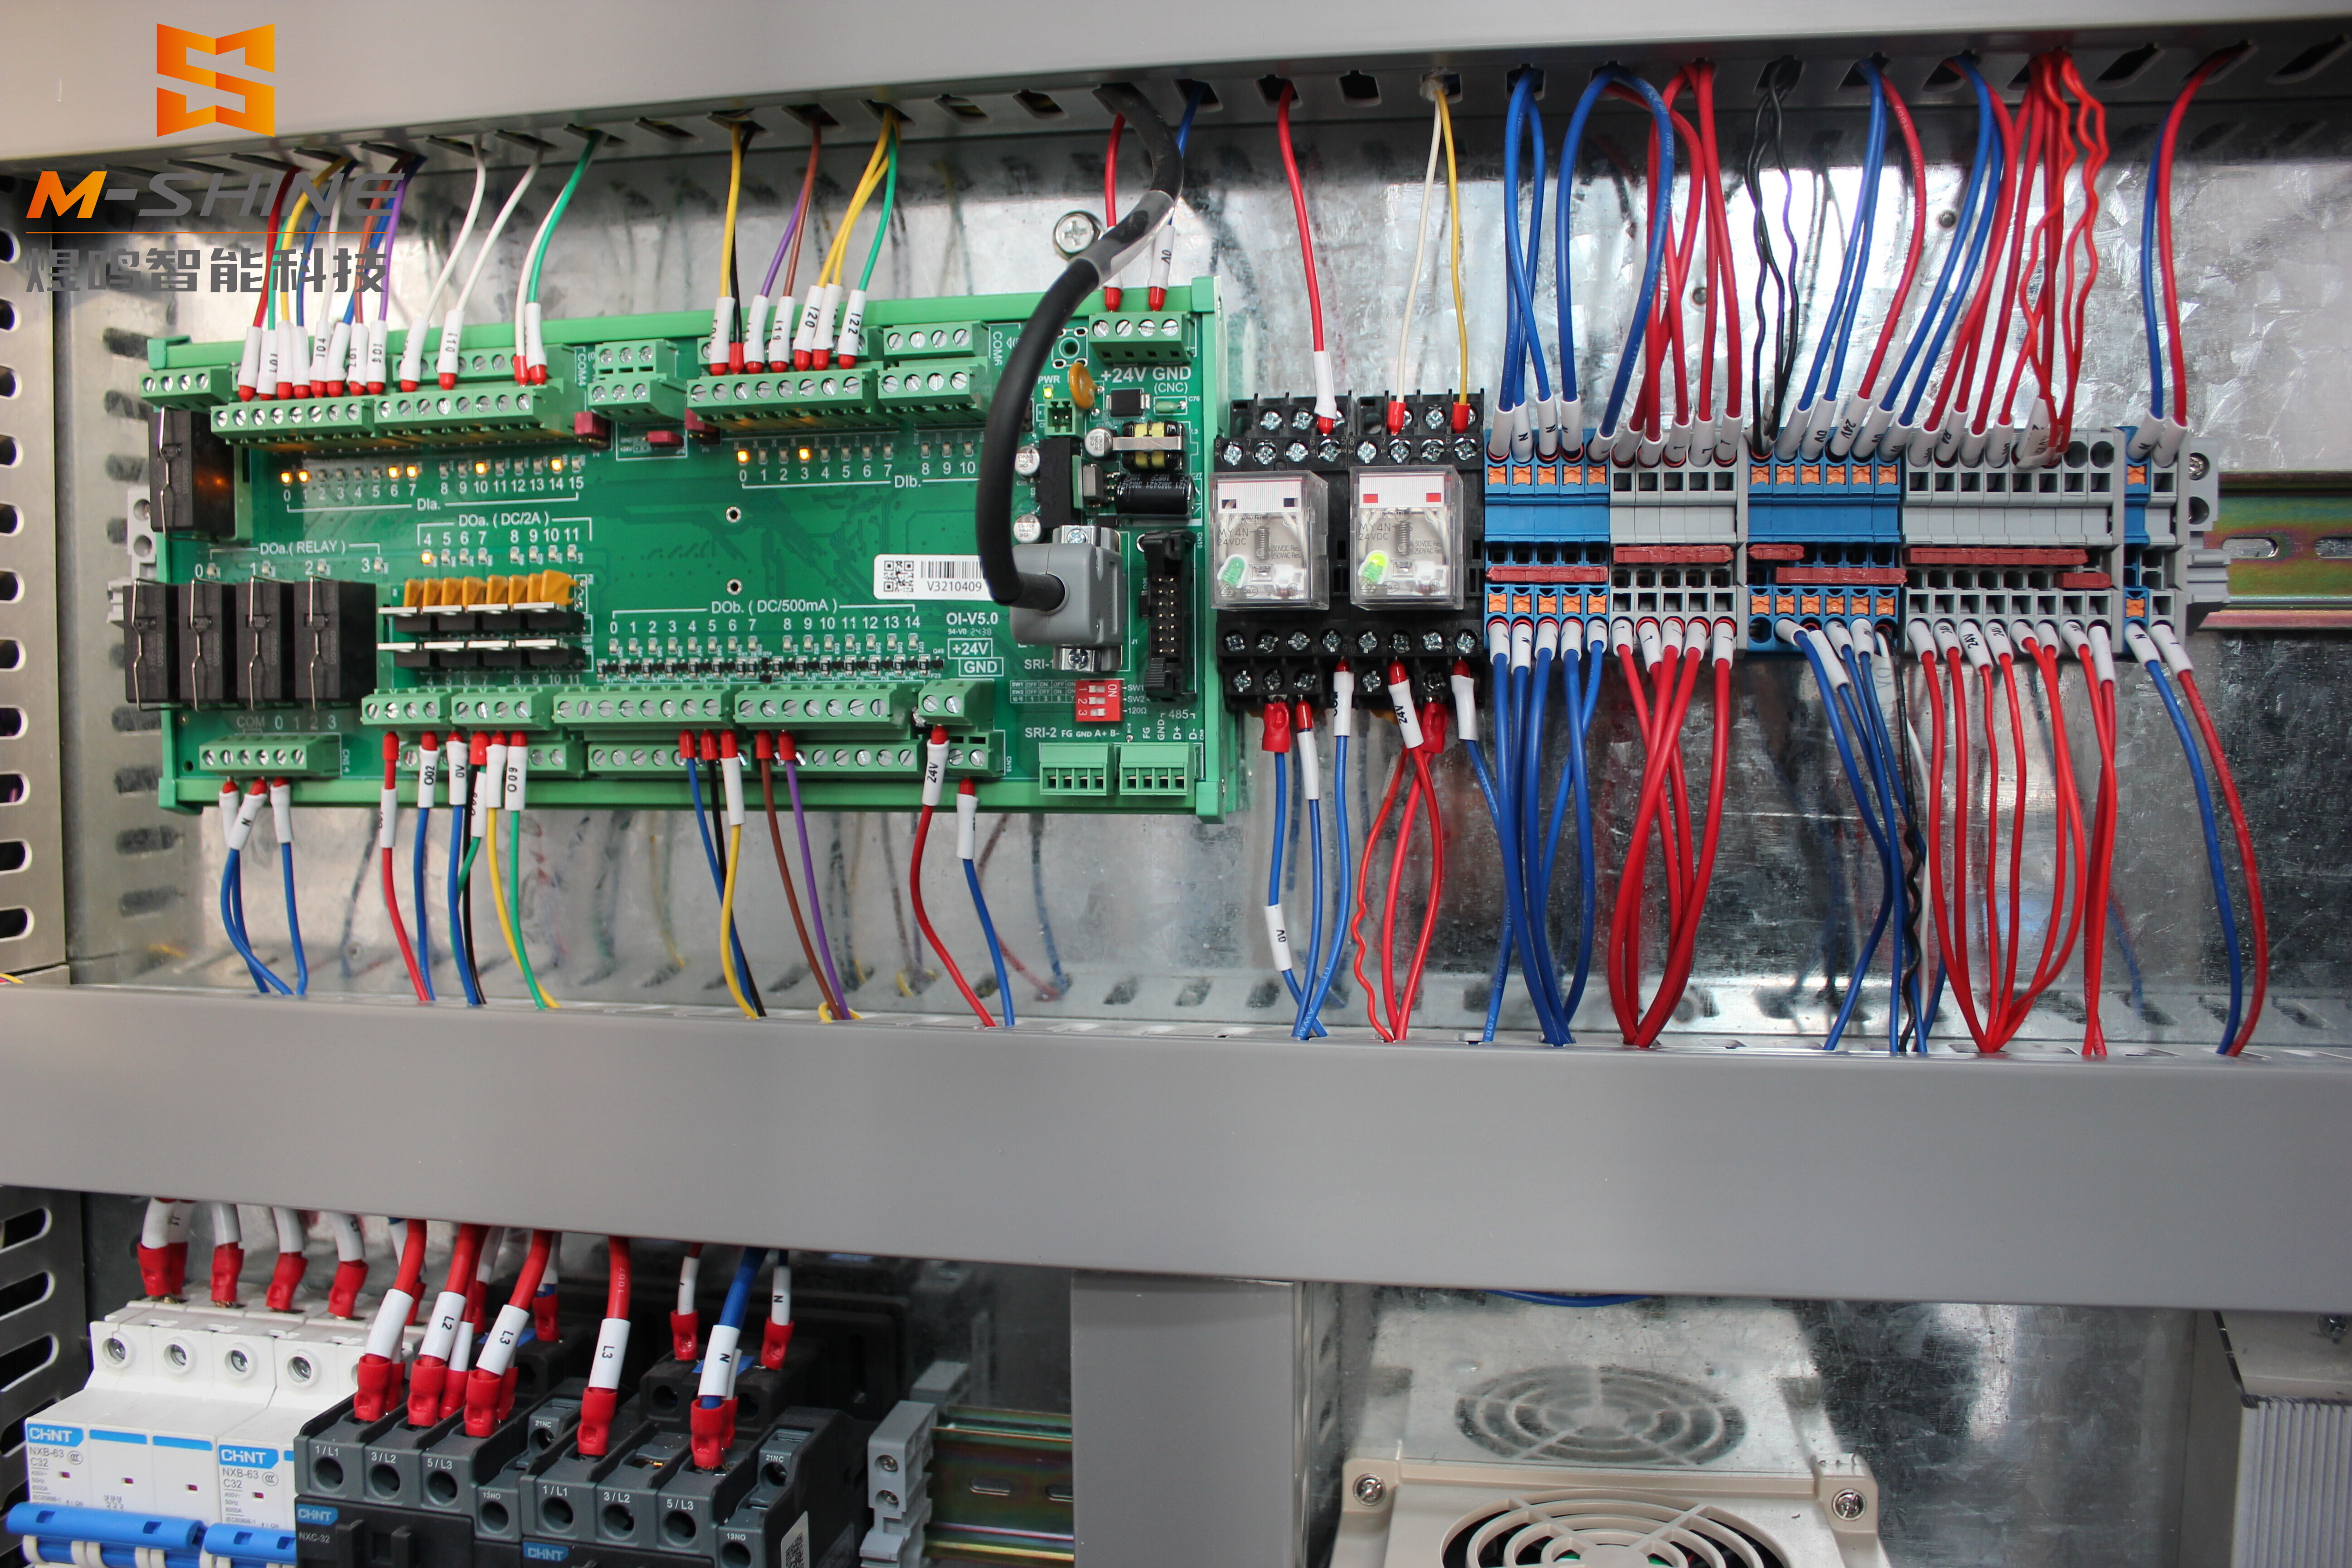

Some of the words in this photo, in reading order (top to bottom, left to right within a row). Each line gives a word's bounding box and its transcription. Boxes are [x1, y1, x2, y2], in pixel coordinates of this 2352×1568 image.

[1037, 376, 1060, 384] PWR
[1101, 368, 1147, 382] +24V
[1152, 367, 1191, 381] GND
[1154, 382, 1188, 394] (CNC)
[1840, 419, 1857, 440] 24V
[739, 469, 747, 481] 0
[761, 468, 766, 480] 1
[780, 467, 788, 480] 2
[800, 466, 808, 479] 3
[821, 466, 829, 479] 4
[842, 466, 850, 478] 5
[863, 465, 872, 477] 6
[884, 464, 892, 477] 7
[921, 463, 930, 475] 8
[943, 462, 951, 475] 9
[960, 461, 976, 474] 10
[284, 489, 291, 502] 0
[303, 489, 308, 501] 1
[319, 488, 326, 500] 2
[338, 486, 344, 500] 3
[354, 485, 362, 498] 4
[372, 485, 380, 498] 5
[391, 484, 398, 497] 6
[409, 484, 416, 496] 7
[440, 482, 449, 495] 8
[459, 481, 467, 495] 9
[473, 480, 488, 494] 10
[493, 480, 507, 493] 11
[511, 480, 526, 492] 12
[529, 478, 544, 491] 13
[549, 477, 564, 490] 14
[569, 476, 584, 490] 15
[423, 533, 432, 546] 4
[443, 532, 451, 545] 5
[460, 531, 469, 545] 6
[478, 531, 487, 545] 7
[510, 529, 519, 544] 8
[529, 529, 538, 543] 9
[543, 528, 559, 542] 10
[564, 527, 578, 542] 11
[296, 540, 338, 554] RELAY
[194, 563, 204, 578] 0
[250, 562, 256, 575] 1
[304, 560, 314, 575] 2
[361, 557, 370, 573] 3
[927, 581, 982, 592] V3210409
[711, 601, 745, 614] DOb.
[757, 598, 828, 612] DC/500mA
[609, 621, 618, 634] 0
[630, 621, 636, 633] 1
[649, 621, 657, 633] 2
[668, 620, 676, 633] 3
[688, 620, 696, 632] 4
[708, 619, 716, 632] 5
[728, 619, 737, 632] 6
[749, 618, 756, 631] 7
[783, 617, 792, 630] 8
[804, 617, 812, 630] 9
[820, 617, 836, 630] 10
[842, 616, 856, 629] 11
[862, 616, 878, 629] 12
[884, 616, 899, 629] 13
[905, 615, 920, 628] 14
[946, 612, 998, 625] OI-V5.0
[952, 642, 989, 655] +24V
[1962, 633, 1979, 650] 24V
[964, 660, 998, 673] GND
[513, 674, 520, 685] 8
[533, 674, 539, 684] 9
[549, 674, 561, 684] 10
[568, 674, 580, 684] 11
[1107, 684, 1117, 697] ON
[1169, 710, 1189, 719] 485
[1394, 705, 1407, 725] 24V
[236, 715, 265, 728] COM
[274, 715, 284, 730] 0
[328, 715, 337, 730] 3
[1025, 727, 1057, 738] SRI-2
[1061, 729, 1073, 737] FG
[1142, 727, 1151, 739] FG
[1157, 719, 1165, 741] GND
[1173, 726, 1181, 740] D+
[1189, 728, 1197, 740] D-
[456, 764, 465, 778] 0V
[926, 761, 938, 784] 24V
[1275, 929, 1287, 943] 0V
[441, 1315, 455, 1331] L2
[500, 1329, 514, 1346] L3
[601, 1344, 615, 1360] L3
[535, 1419, 552, 1428] 21NC
[29, 1446, 64, 1458] NXB-63
[765, 1454, 784, 1463] 21NC
[30, 1457, 49, 1468] C32
[222, 1467, 259, 1479] NXB-63
[224, 1479, 243, 1489] C32
[299, 1531, 331, 1544] NXC-32
[726, 1533, 746, 1542] 13NO
